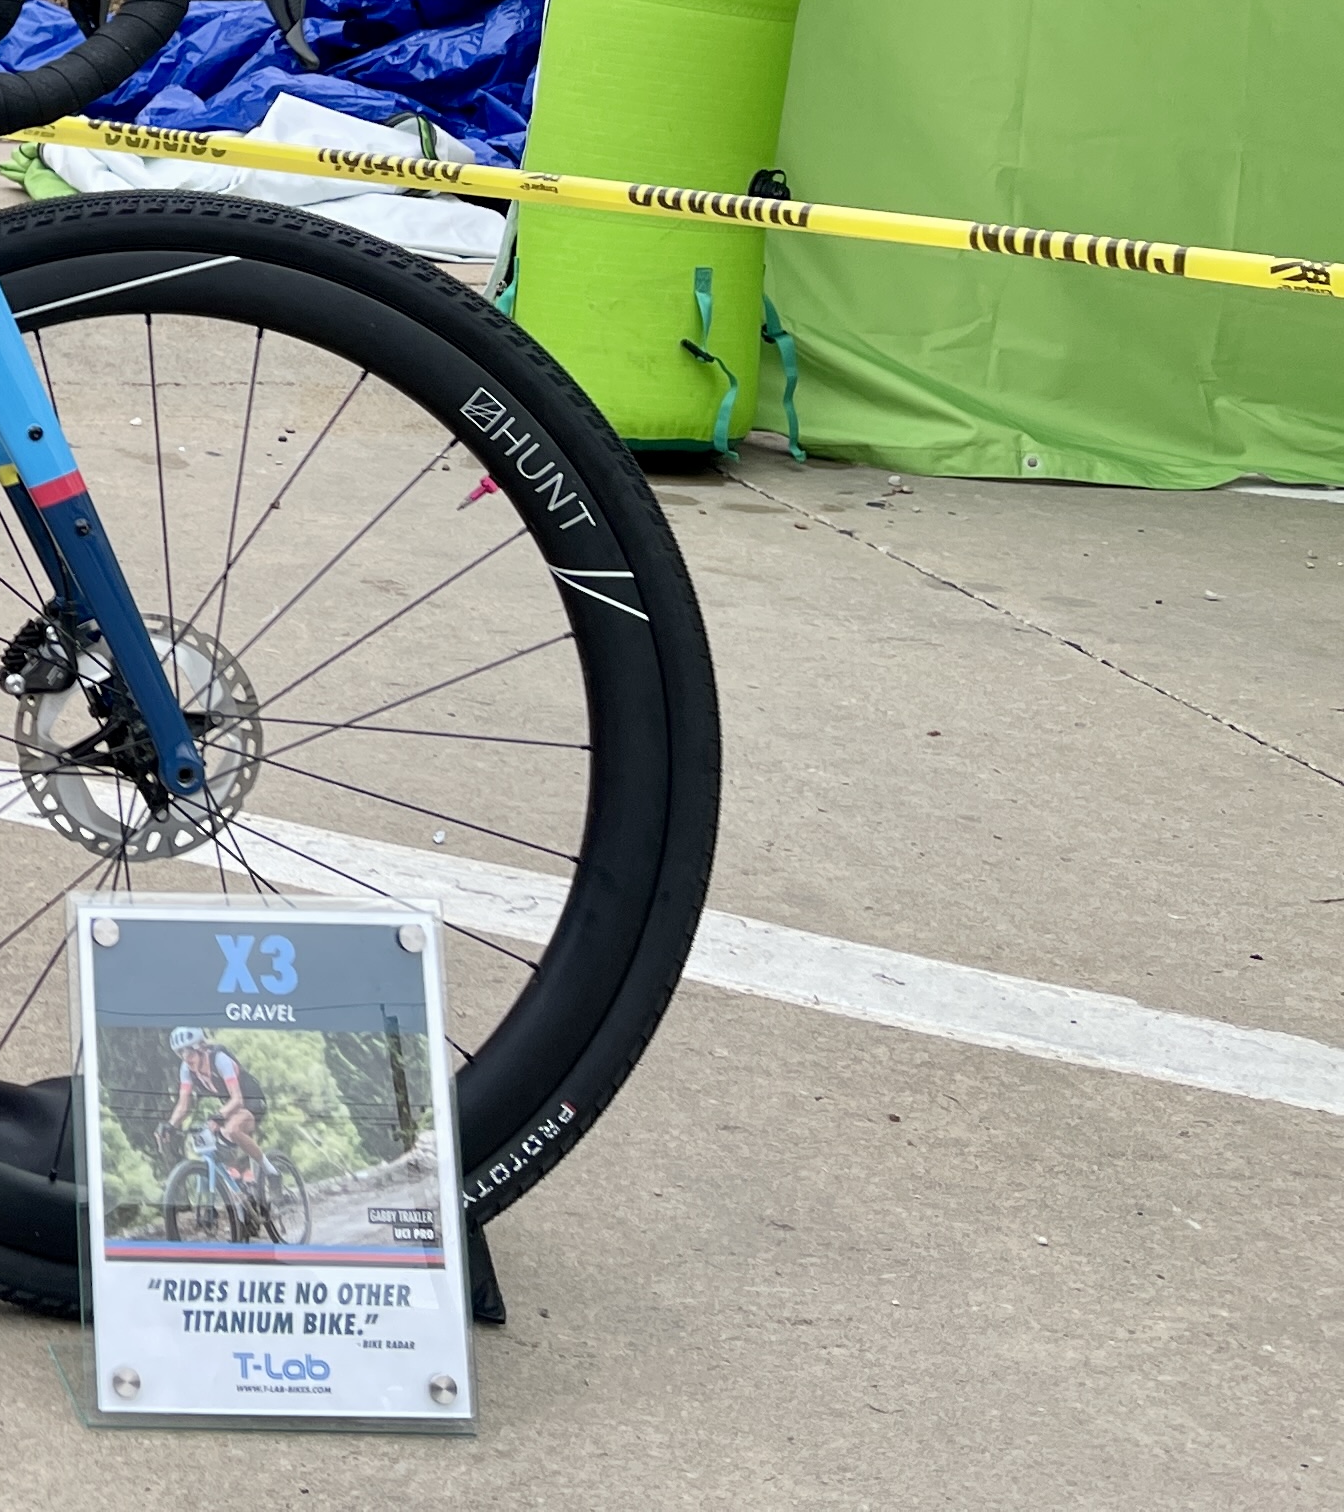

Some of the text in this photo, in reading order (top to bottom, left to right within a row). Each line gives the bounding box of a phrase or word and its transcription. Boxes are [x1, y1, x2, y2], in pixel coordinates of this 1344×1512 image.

[490, 416, 596, 531] HUNT
[215, 934, 299, 996] X3
[224, 1003, 297, 1023] GRAVEL
[462, 1101, 576, 1208] PROTOTY
[413, 1228, 434, 1240] PRO
[238, 1280, 286, 1304] LIKE
[295, 1282, 328, 1305] NO
[337, 1282, 412, 1307] OTHER
[183, 1309, 294, 1334] TITANIUM
[385, 1340, 416, 1350] RADAR
[232, 1351, 331, 1380] T-Lab
